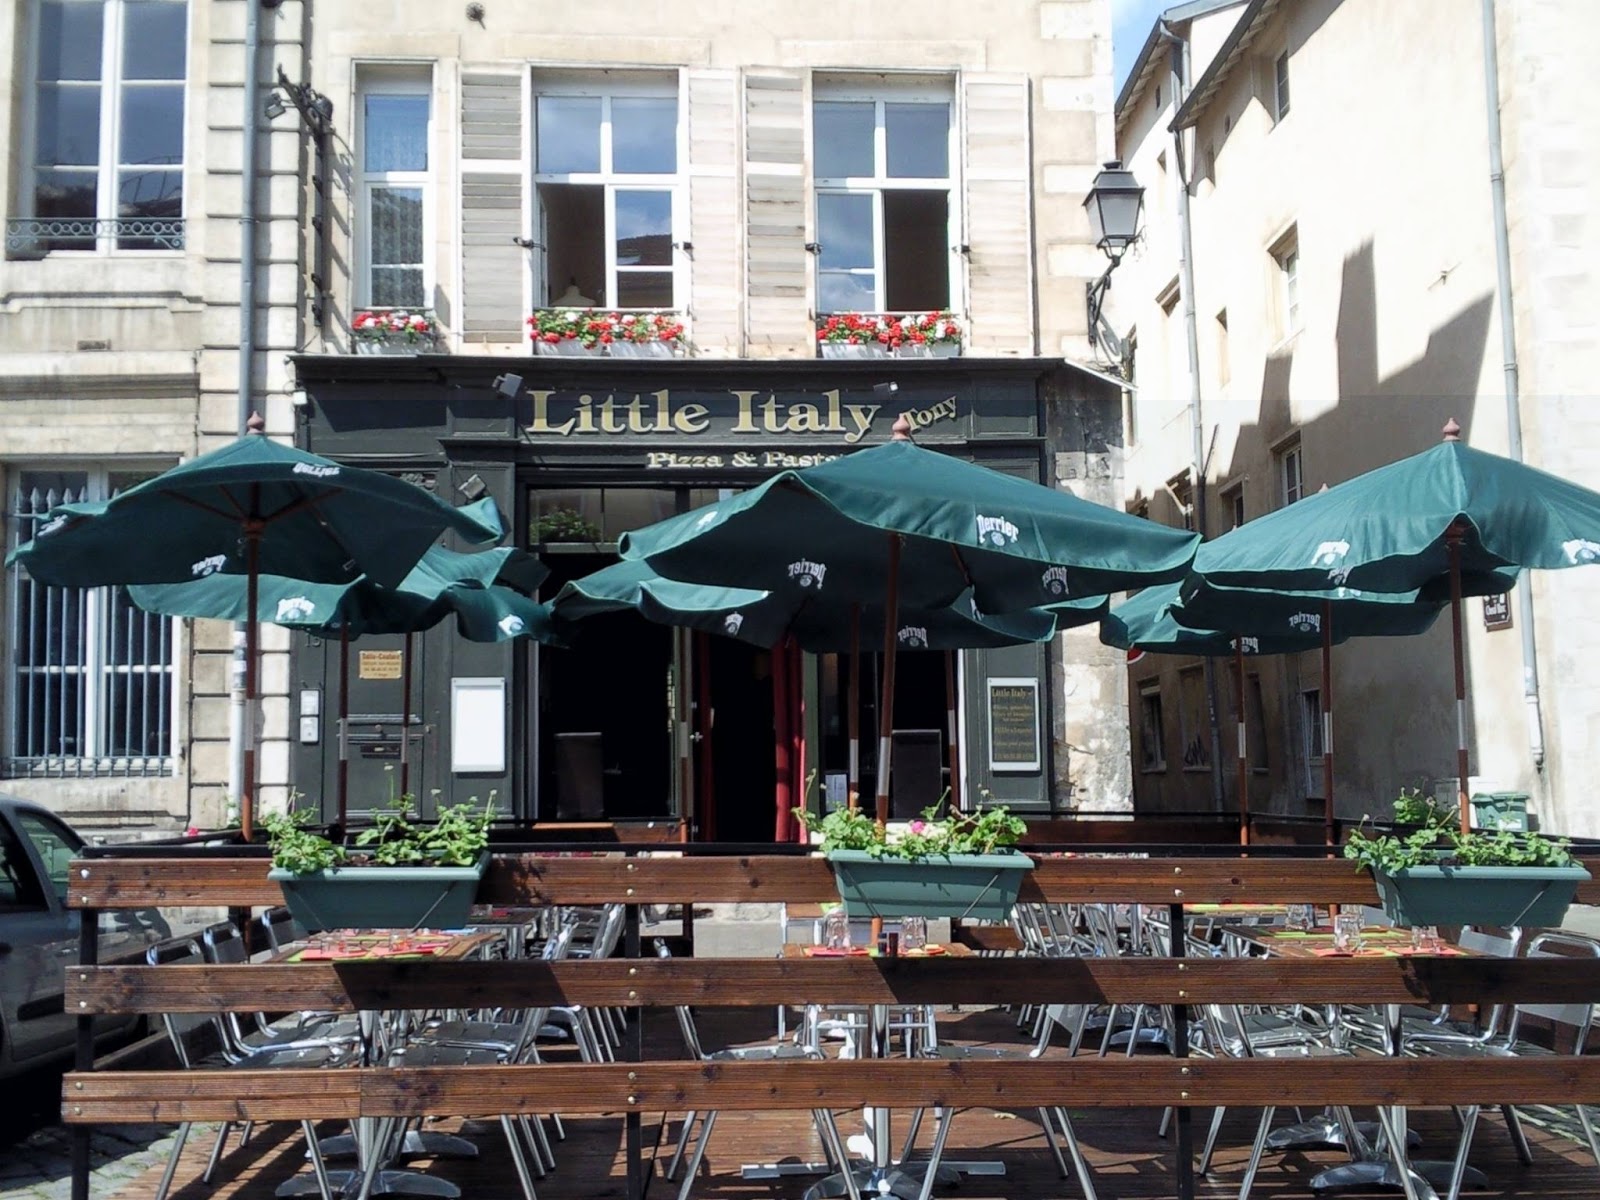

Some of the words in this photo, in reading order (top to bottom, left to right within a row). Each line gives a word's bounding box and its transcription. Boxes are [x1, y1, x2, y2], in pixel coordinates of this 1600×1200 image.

[525, 388, 710, 436] Little
[730, 388, 882, 443] Italy
[903, 395, 957, 432] Tony
[647, 452, 725, 468] Pizza
[731, 451, 758, 468] &
